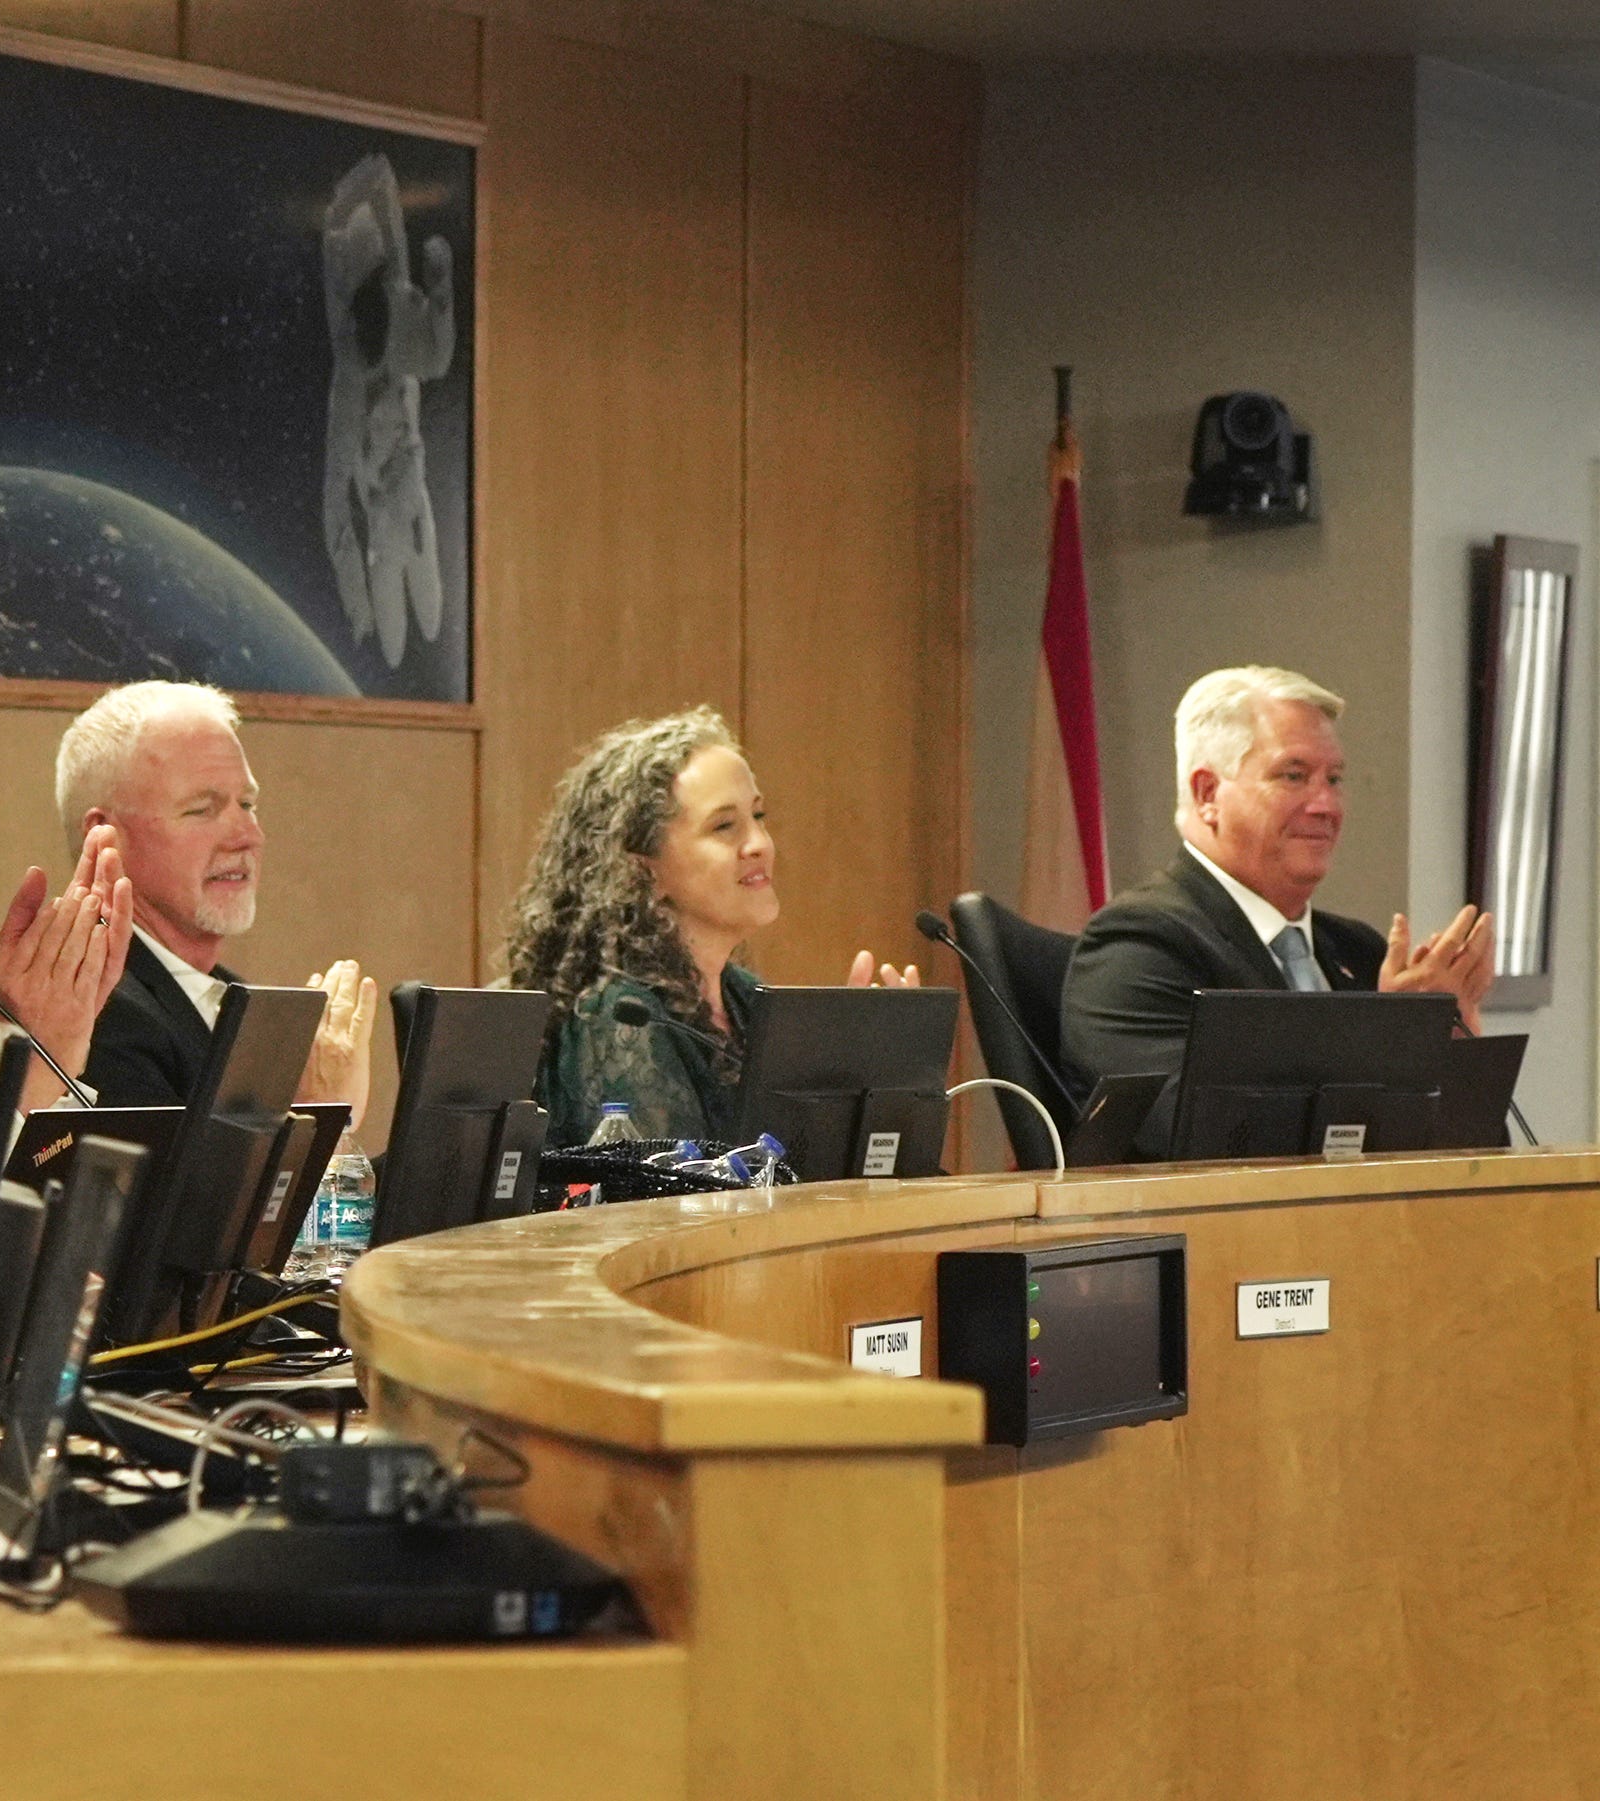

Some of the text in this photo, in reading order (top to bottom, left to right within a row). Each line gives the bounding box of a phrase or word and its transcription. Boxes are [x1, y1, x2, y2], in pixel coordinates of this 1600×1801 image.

[32, 1131, 74, 1167] ThinkPad
[1256, 1288, 1314, 1309] GENE TRENT
[866, 1331, 908, 1356] MATT SUSIN
